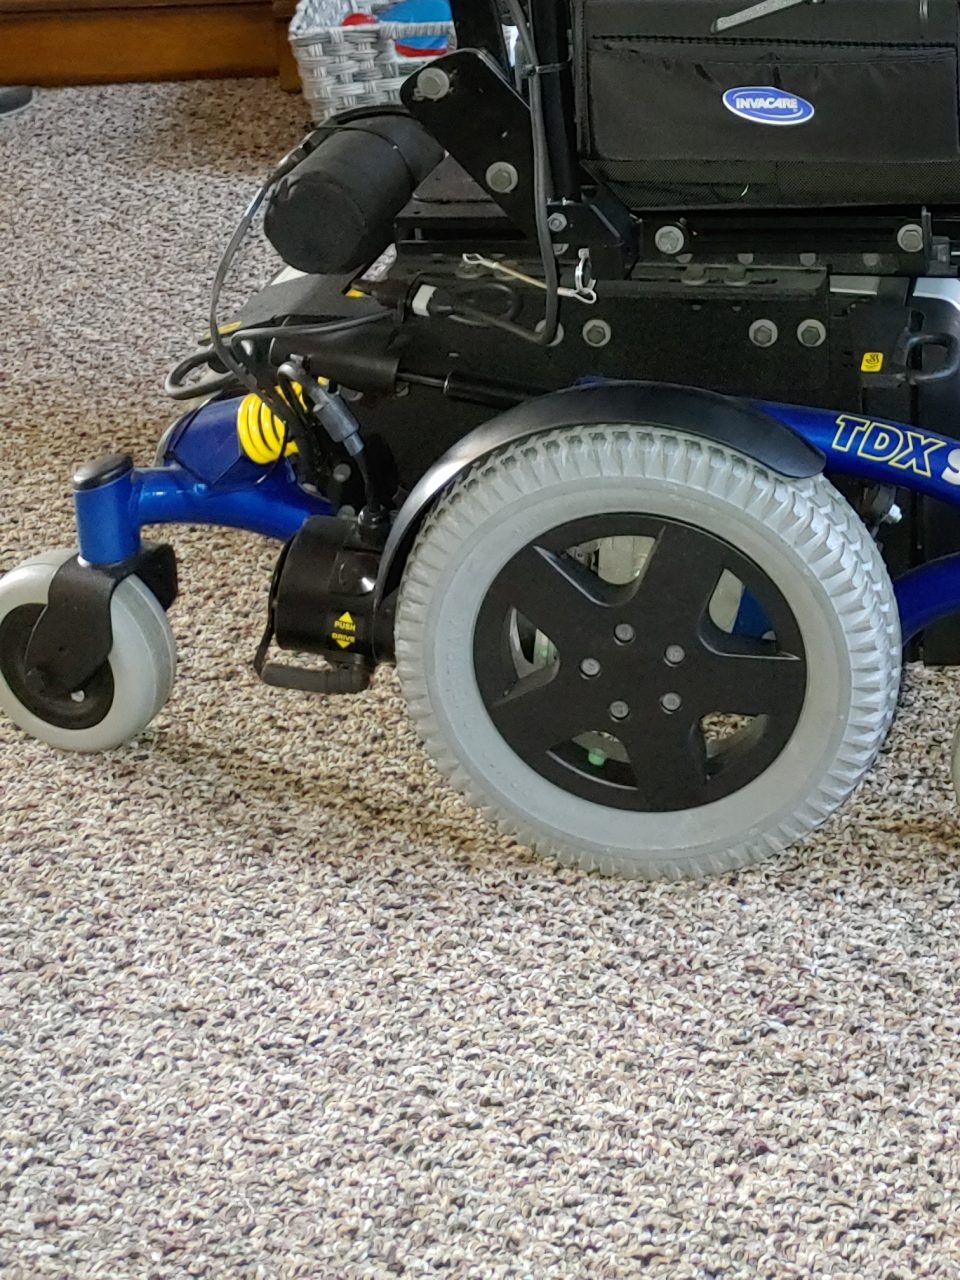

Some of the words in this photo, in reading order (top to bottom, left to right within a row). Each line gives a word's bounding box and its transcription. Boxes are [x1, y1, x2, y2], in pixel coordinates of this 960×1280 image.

[735, 97, 799, 110] INVACARE
[832, 414, 947, 478] TDX
[334, 620, 356, 632] PUSH
